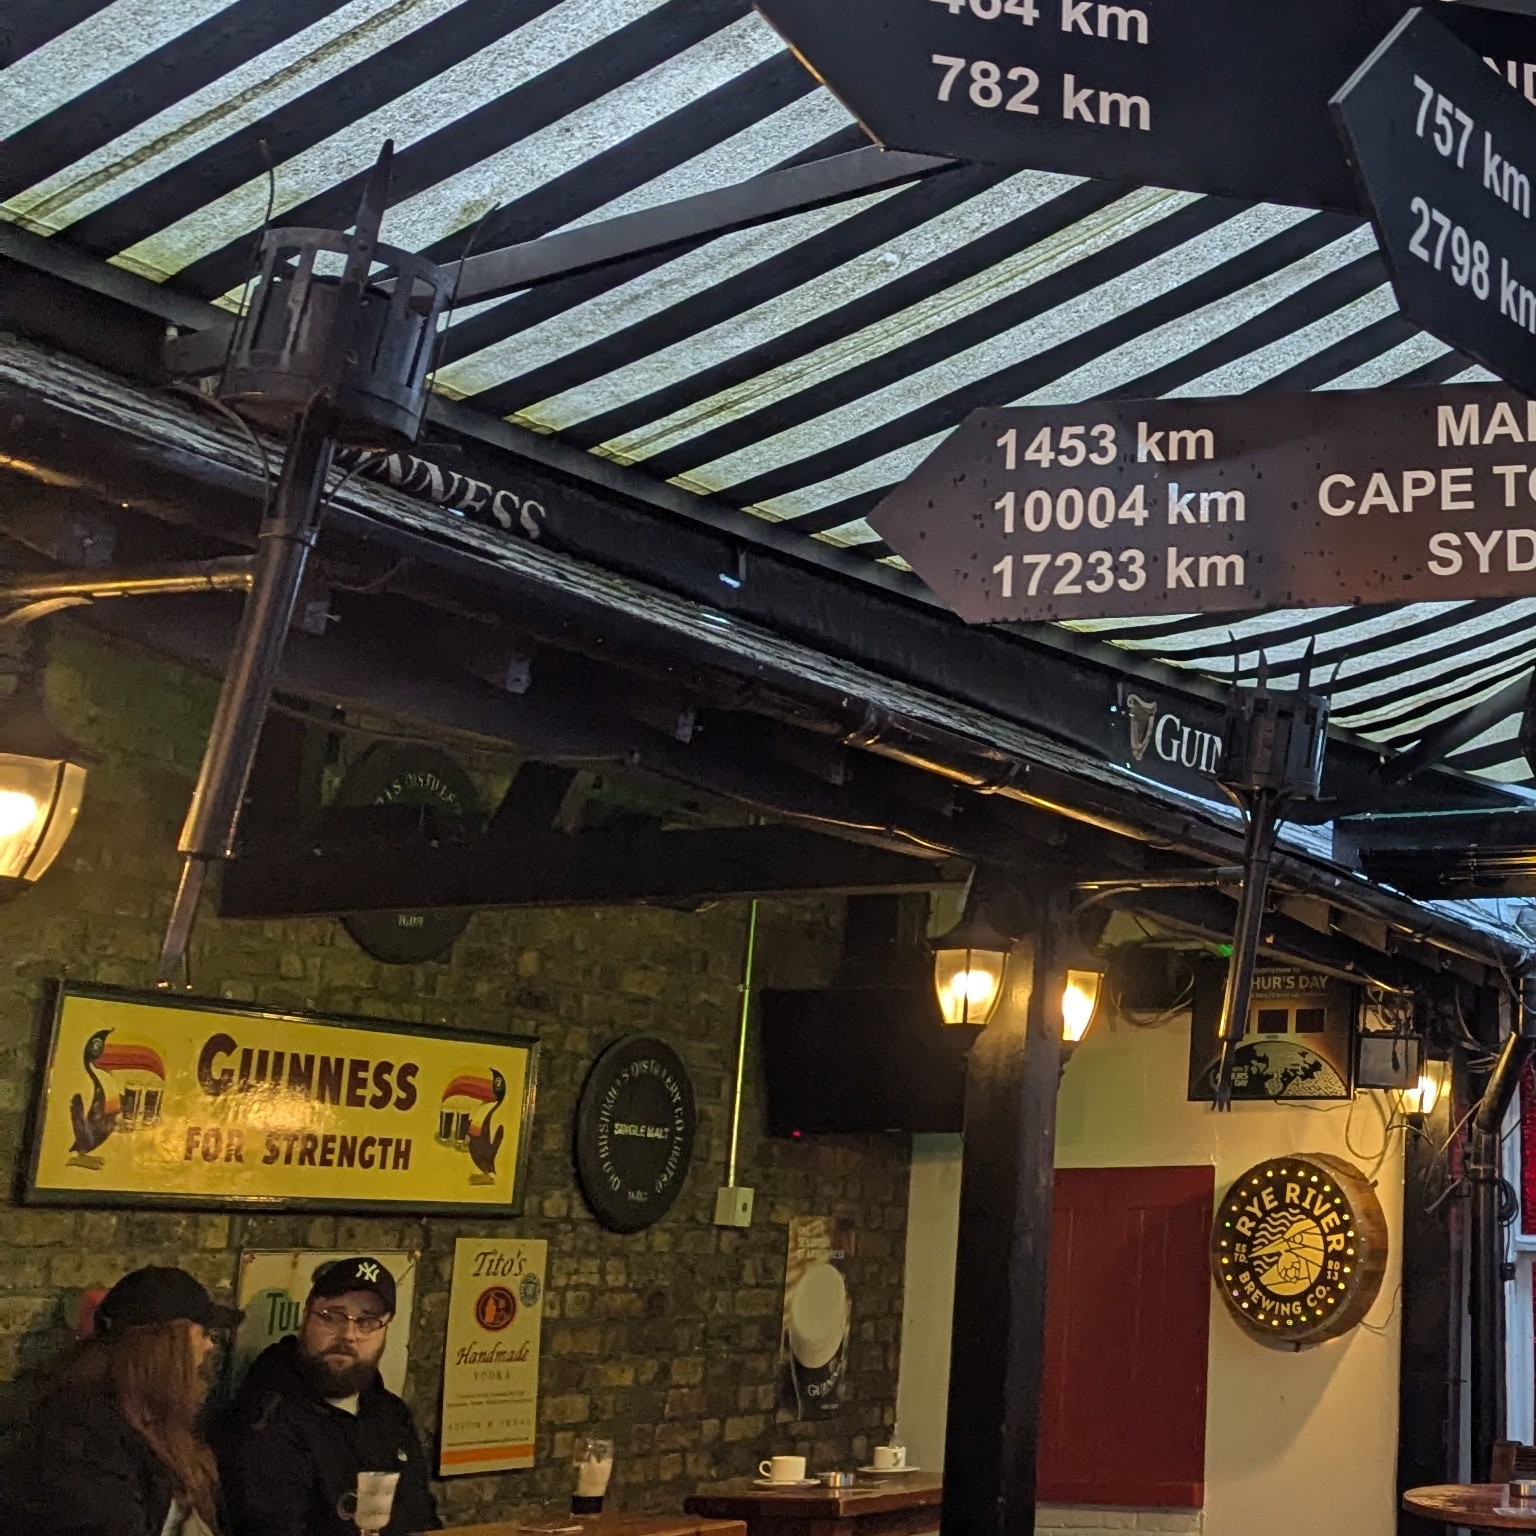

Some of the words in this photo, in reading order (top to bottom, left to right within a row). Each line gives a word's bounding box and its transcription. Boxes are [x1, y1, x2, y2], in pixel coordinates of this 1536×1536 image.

[930, 53, 1040, 116] 782
[1061, 72, 1152, 132] km
[1413, 74, 1475, 169] 757
[1482, 130, 1531, 219] km
[1408, 196, 1490, 301] 2798
[995, 422, 1119, 471] 1453
[1136, 421, 1215, 463] km
[994, 484, 1150, 534] 10004
[1166, 482, 1246, 525] km
[1318, 467, 1475, 517] CAPE
[992, 549, 1148, 599] 17233
[1165, 546, 1246, 590] km
[1299, 974, 1330, 990] DAY
[196, 1031, 421, 1113] GUINNESS
[184, 1124, 245, 1165] FOR
[261, 1129, 413, 1172] STRENGTH
[1235, 1186, 1279, 1237] RYE
[1285, 1182, 1345, 1254] RIVER
[355, 1262, 381, 1284] NY
[472, 1248, 527, 1278] Tito's
[1238, 1270, 1302, 1317] BREWING
[1306, 1285, 1331, 1308] CO.
[455, 1339, 530, 1366] Handmade
